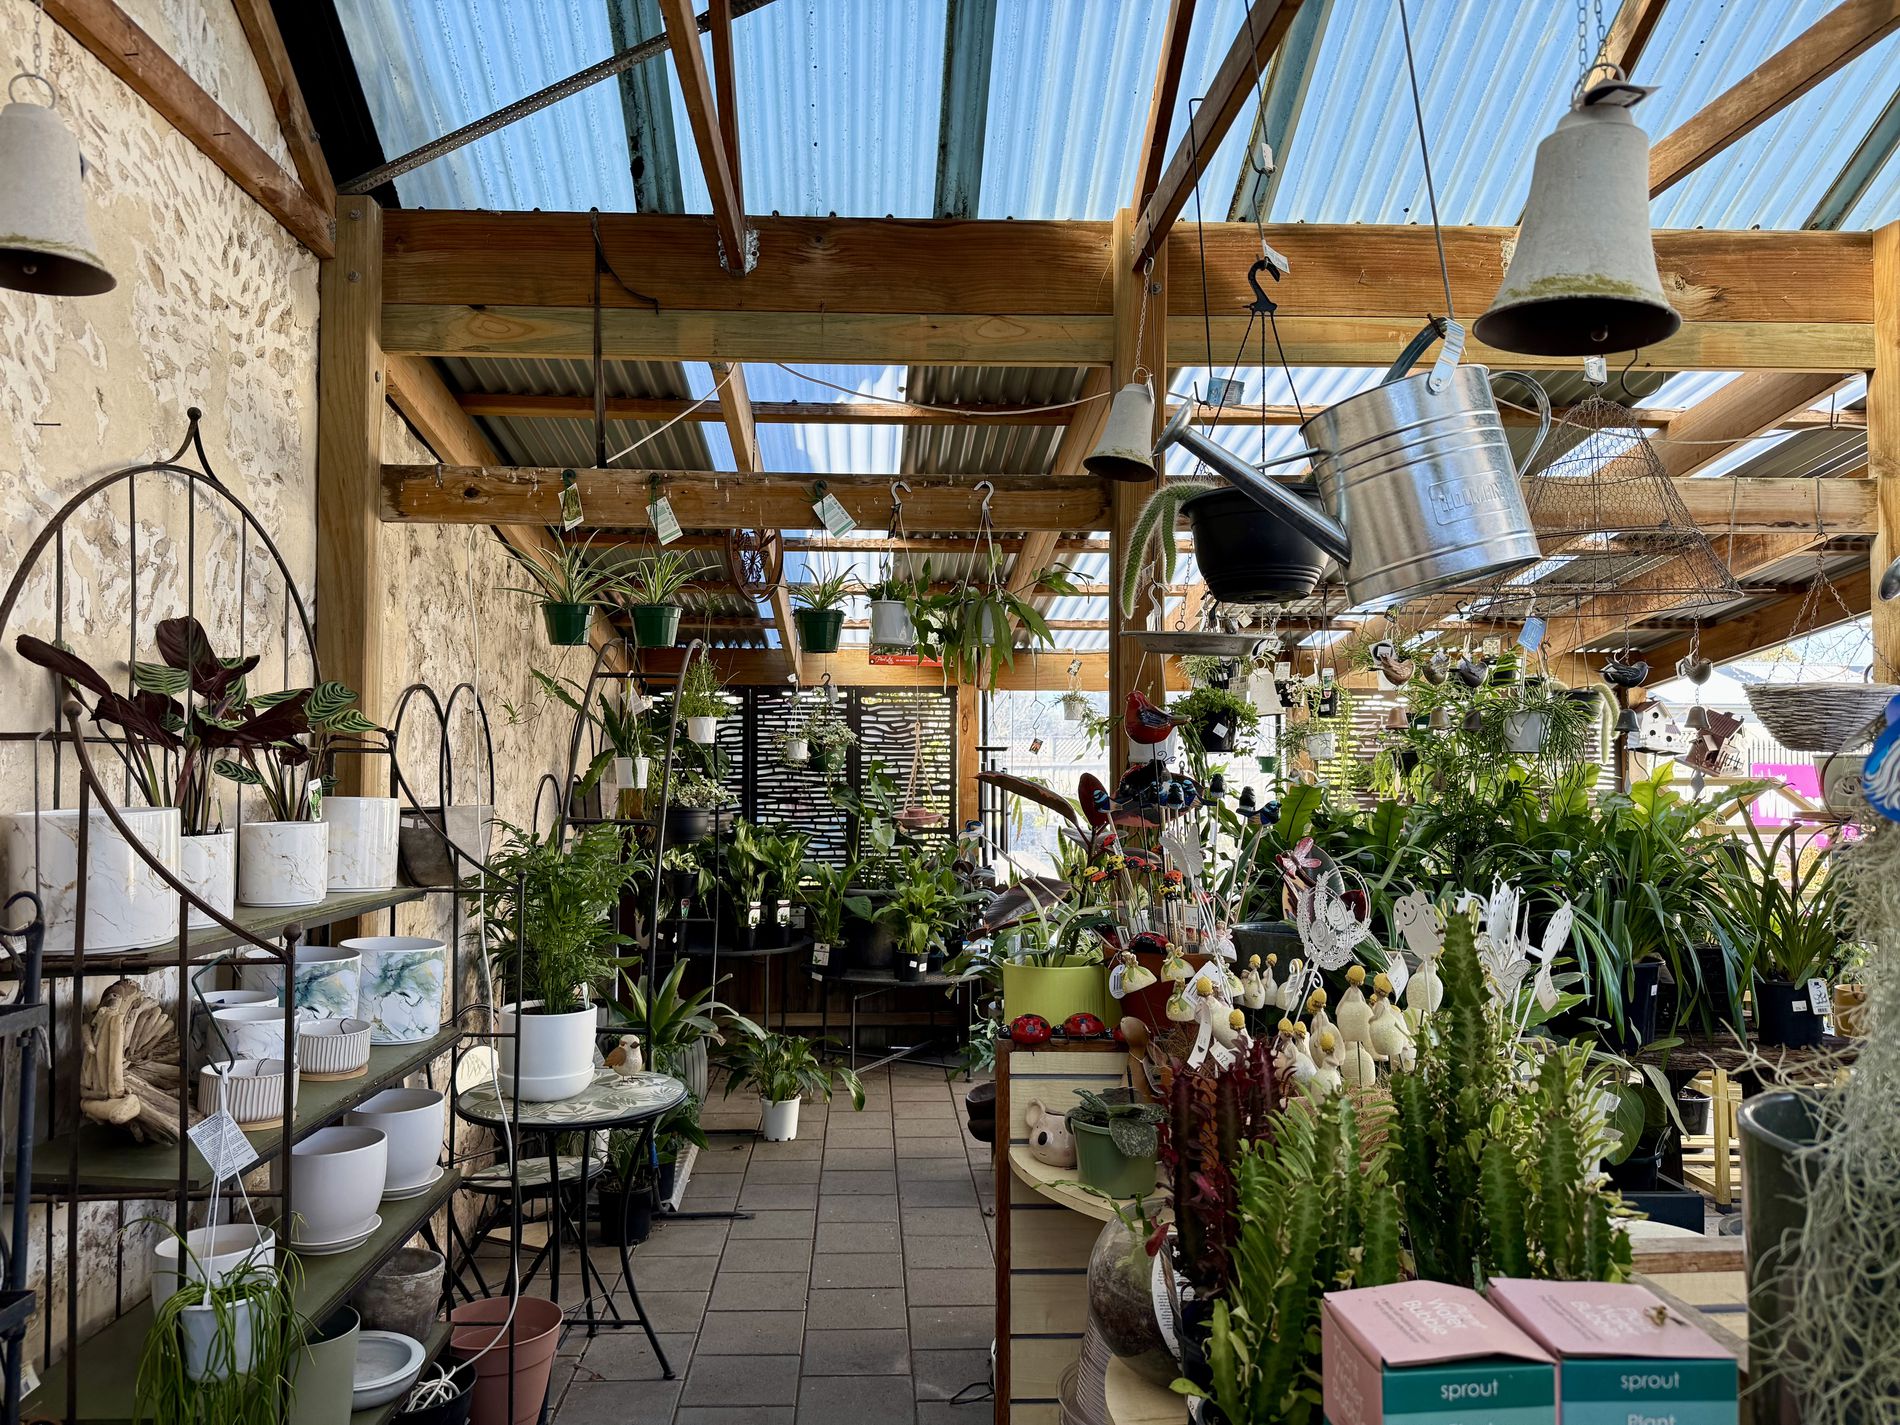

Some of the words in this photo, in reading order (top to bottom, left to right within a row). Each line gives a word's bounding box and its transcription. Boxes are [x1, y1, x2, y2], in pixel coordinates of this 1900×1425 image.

[1402, 1299, 1448, 1336] Bubble
[1440, 1378, 1499, 1401] sprout
[1620, 1371, 1680, 1393] sprout
